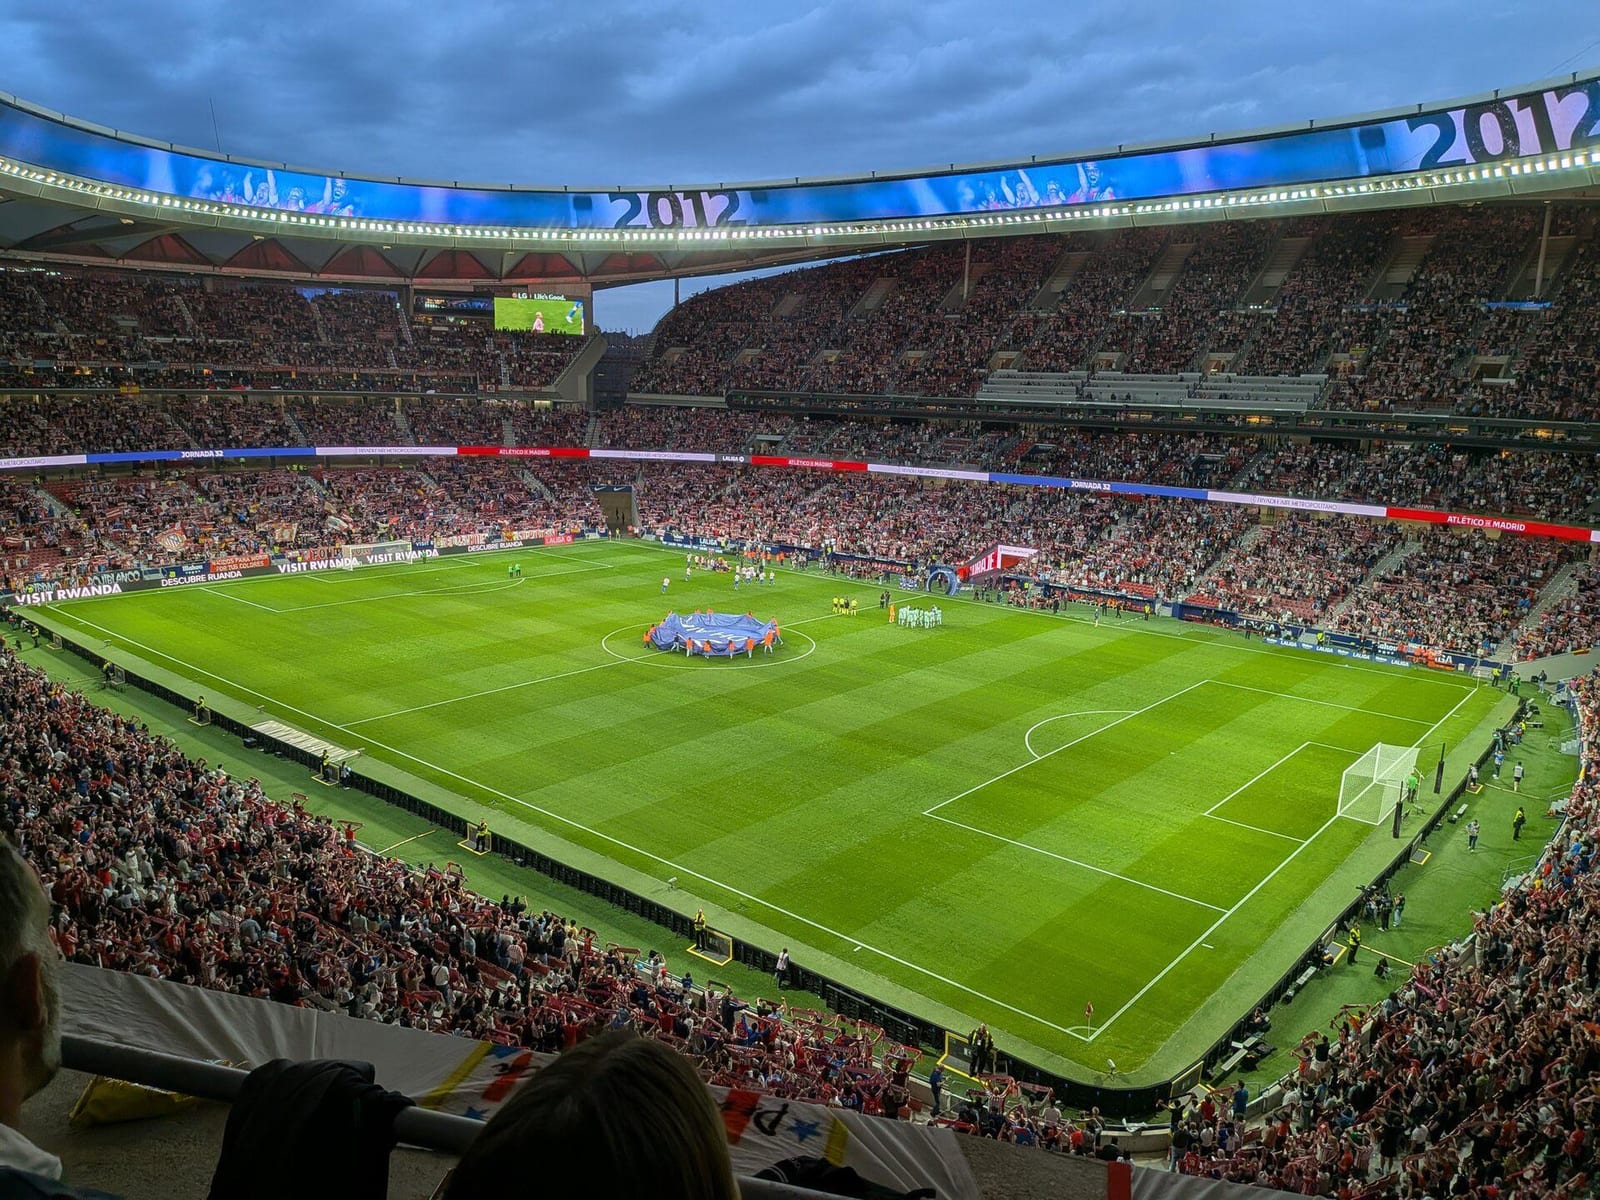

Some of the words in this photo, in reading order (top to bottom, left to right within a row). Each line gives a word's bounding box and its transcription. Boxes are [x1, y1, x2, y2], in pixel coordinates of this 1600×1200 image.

[1406, 80, 1600, 169] 2012
[608, 190, 747, 228] 2012
[181, 450, 214, 458] JORNADA
[1071, 481, 1102, 489] JORNADA
[1447, 515, 1484, 526] ATLÉTICO
[1492, 520, 1526, 531] MADRID
[468, 543, 499, 552] DESCUBRE
[500, 541, 523, 549] RUANDA
[278, 561, 310, 573] VISIT
[310, 557, 360, 570] RWANDA
[367, 553, 393, 564] VISIT
[161, 574, 207, 587] DESCUBRE
[207, 570, 242, 581] RUANDA
[15, 590, 53, 605] VISIT
[57, 583, 122, 600] RWANDA
[1280, 640, 1297, 648] LALIGA
[1352, 652, 1370, 660] LALIGA
[1391, 659, 1410, 667] LALIGA
